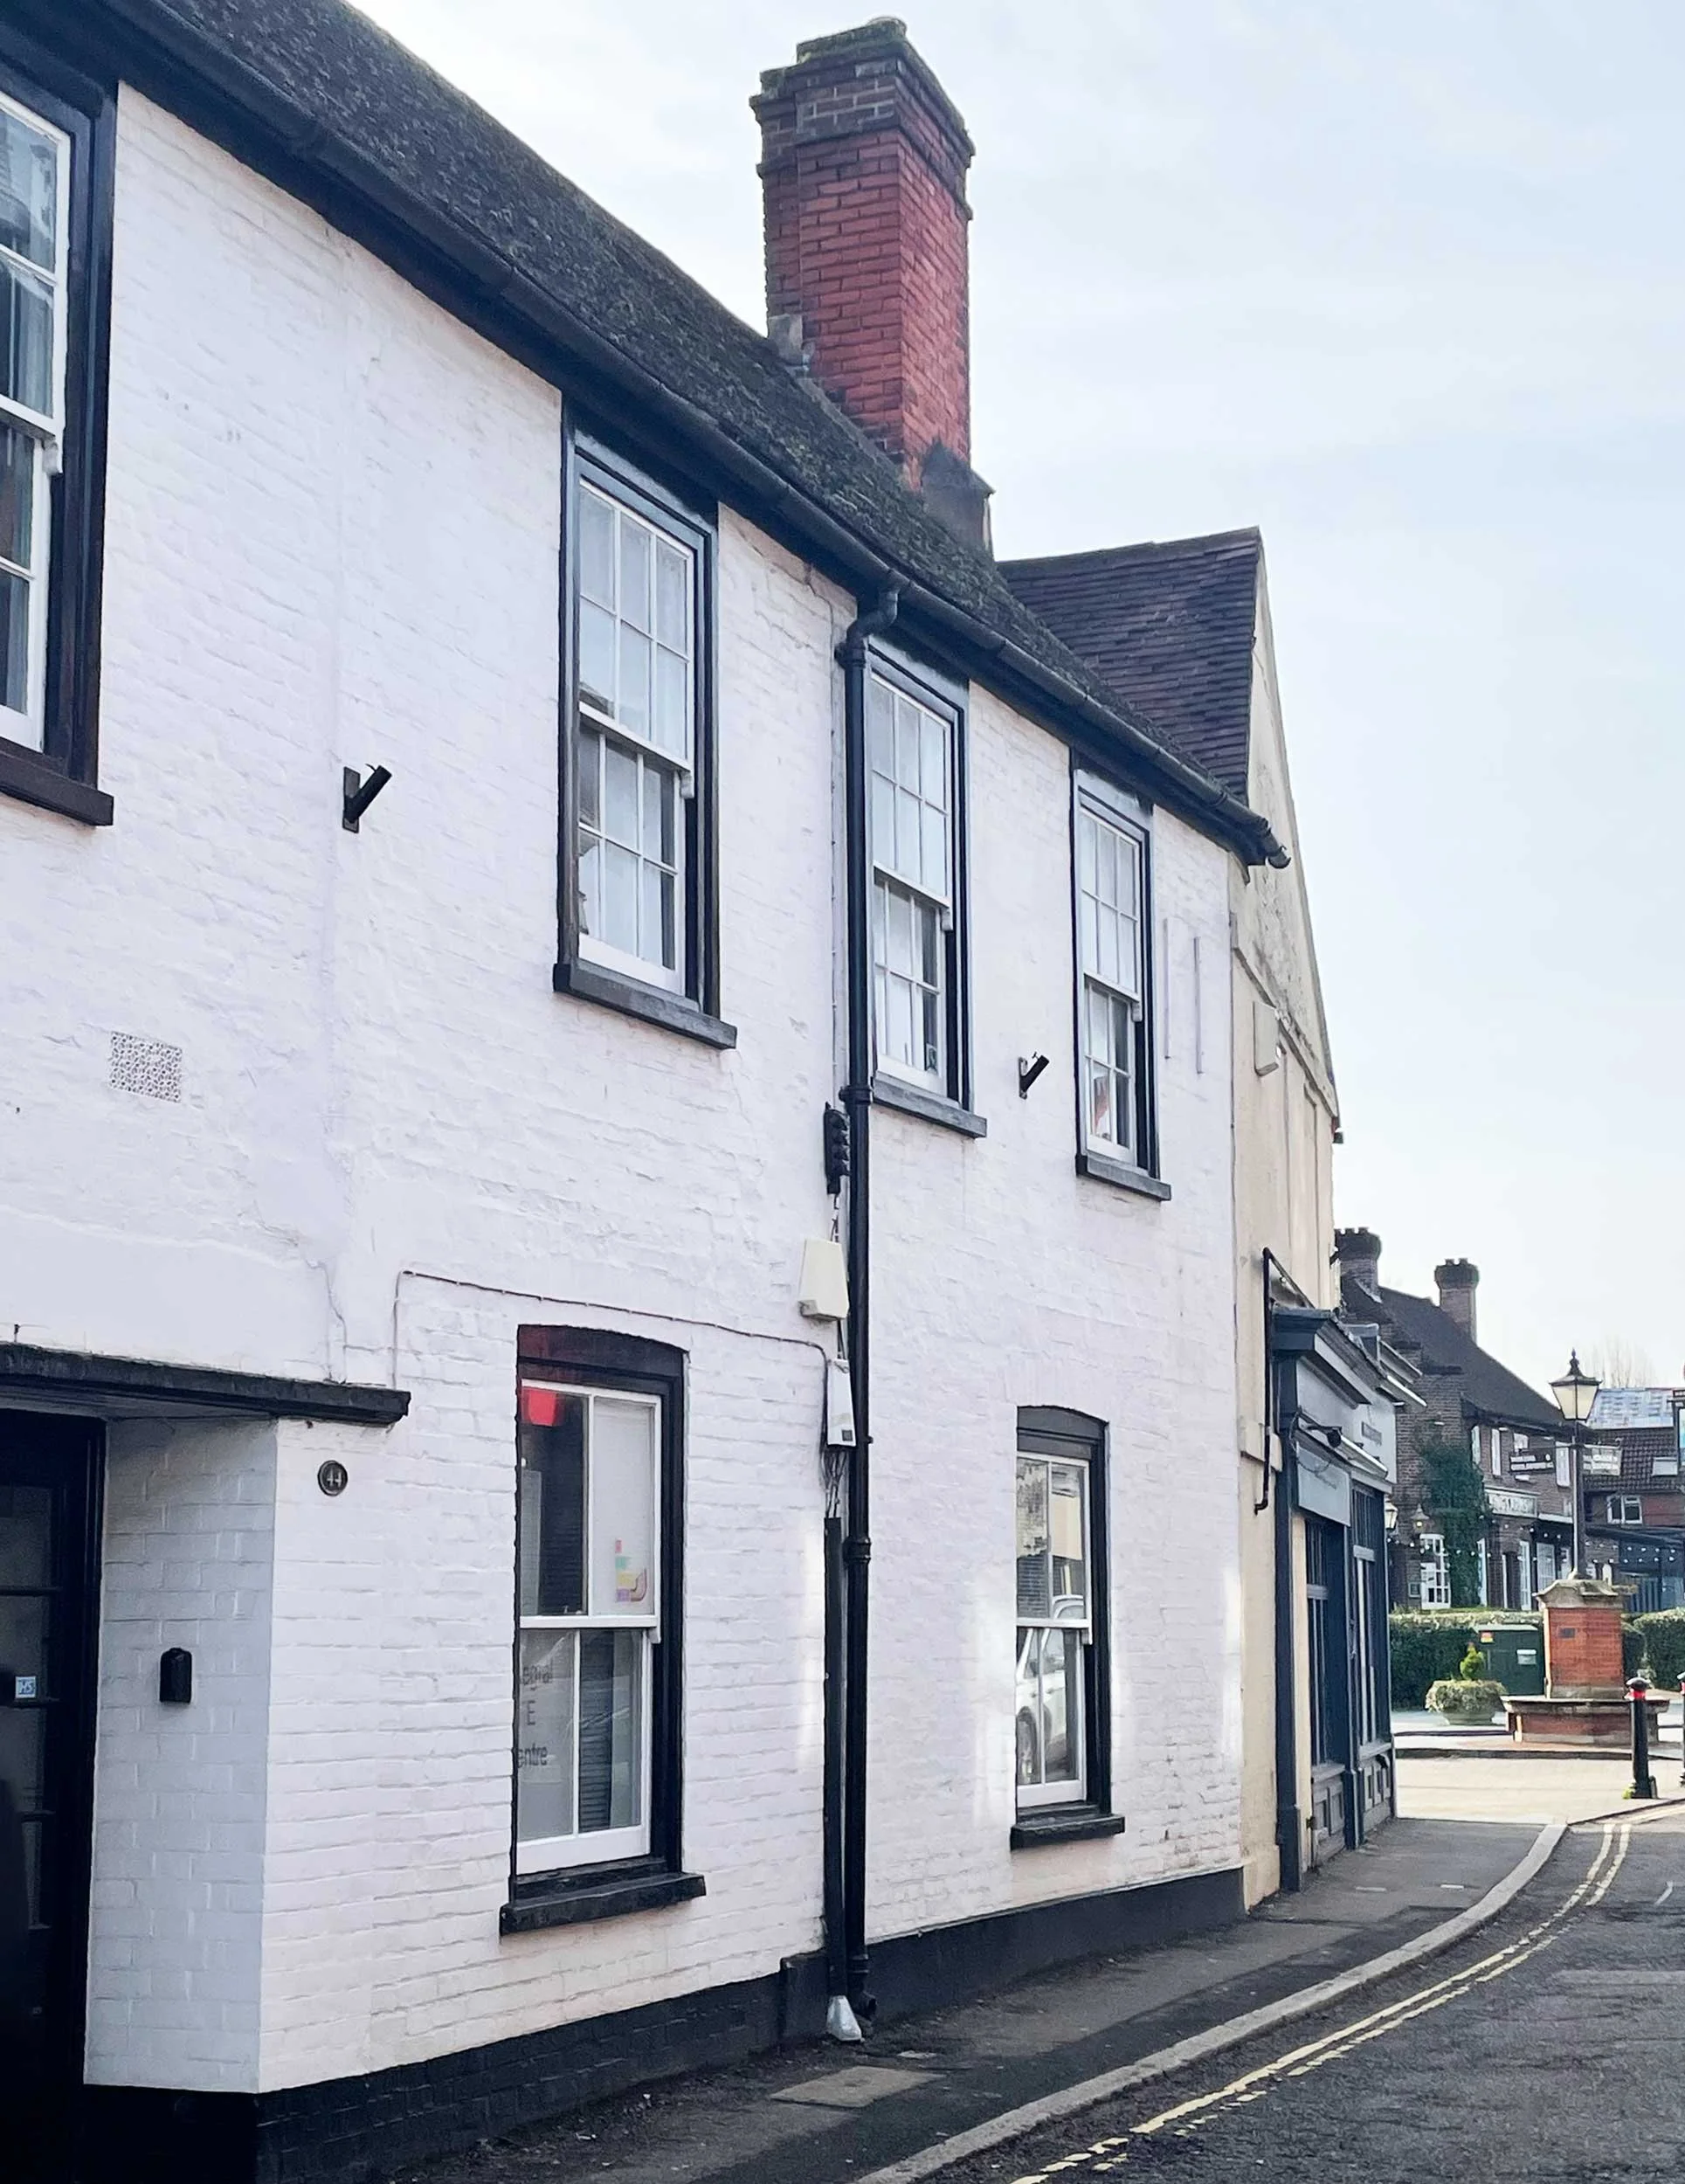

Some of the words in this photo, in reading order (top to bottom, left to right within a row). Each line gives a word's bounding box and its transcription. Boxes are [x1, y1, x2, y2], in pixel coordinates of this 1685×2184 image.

[326, 1468, 342, 1487] 44
[525, 1699, 535, 1726] E
[518, 1743, 549, 1769] entre
